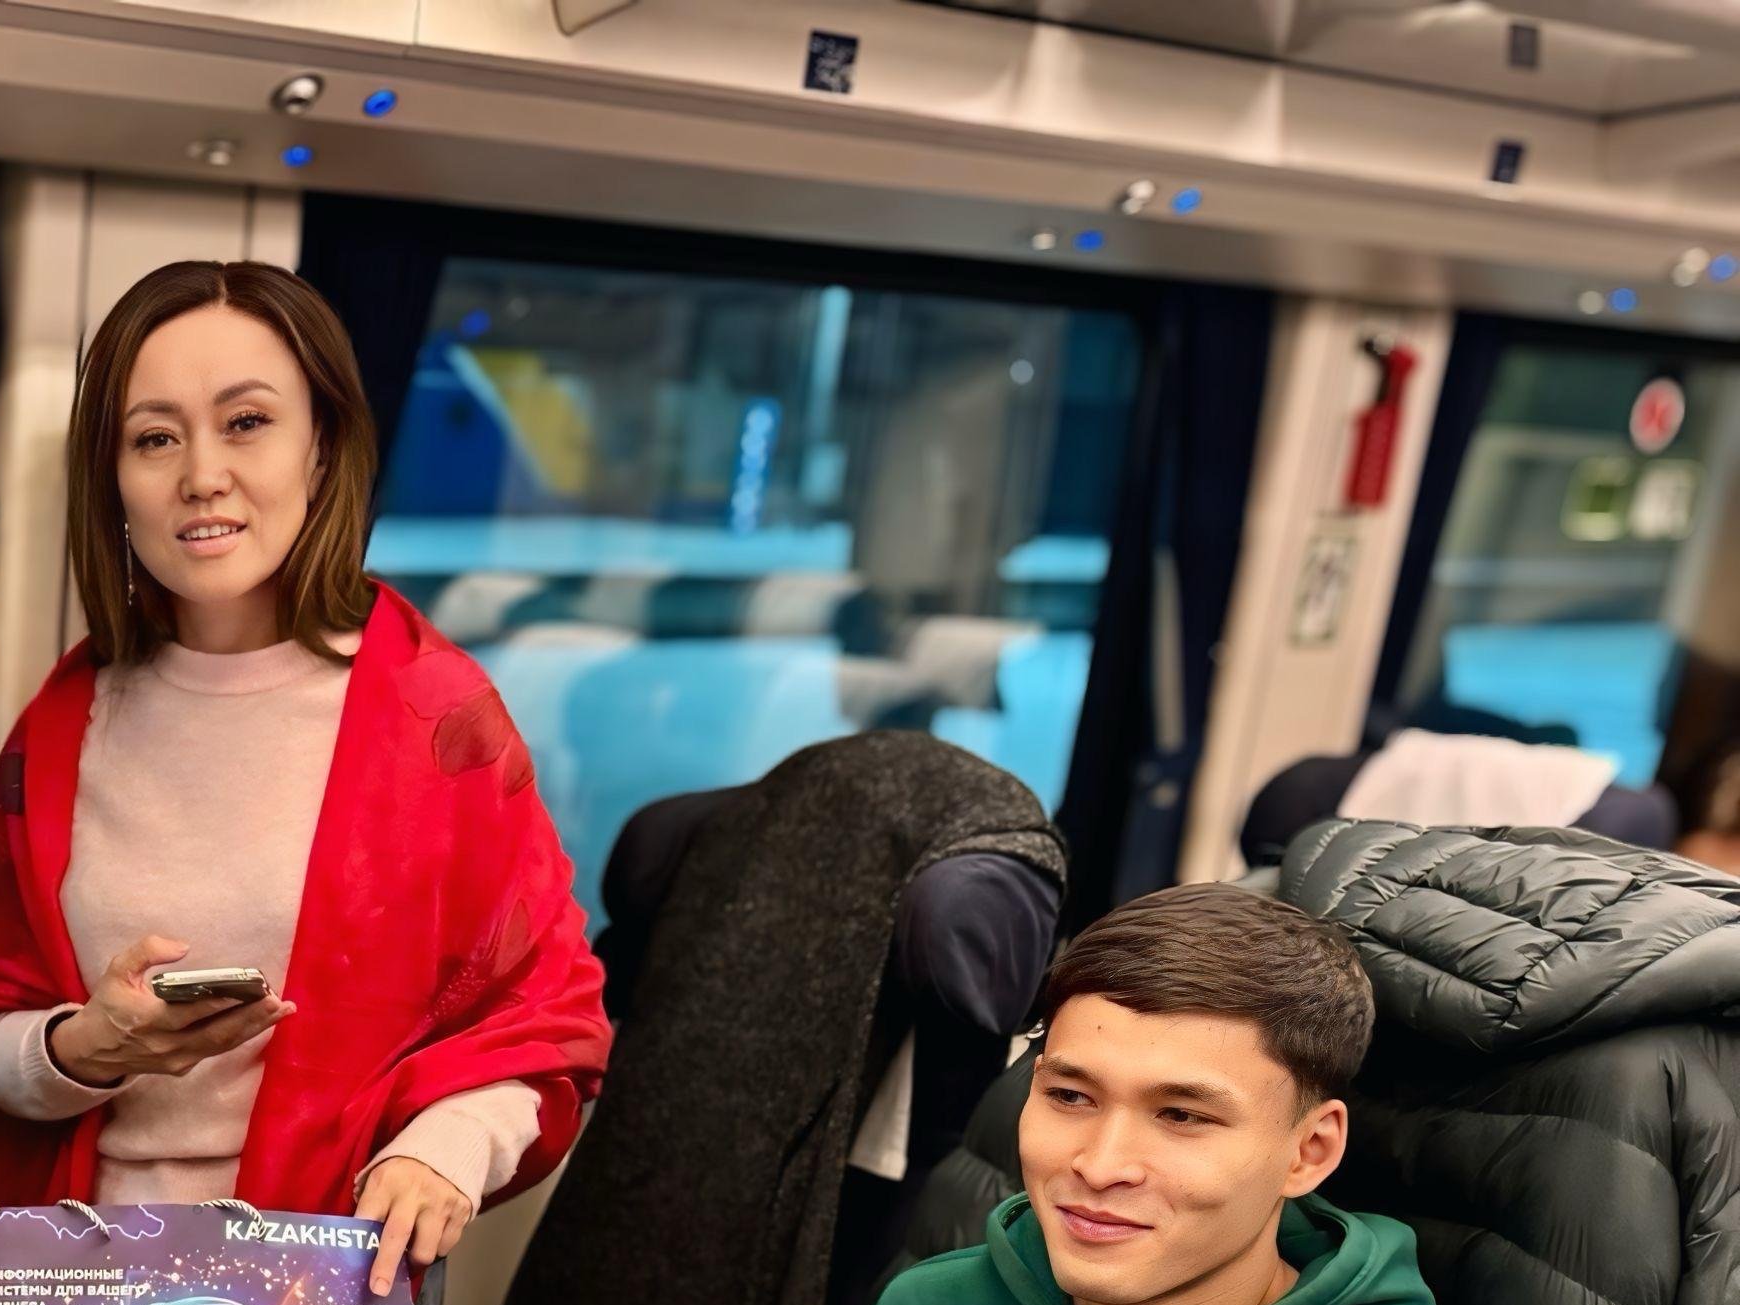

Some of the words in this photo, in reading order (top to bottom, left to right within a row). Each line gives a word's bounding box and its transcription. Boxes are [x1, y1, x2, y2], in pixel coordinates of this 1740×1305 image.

[225, 1219, 380, 1250] KAZAKHSTA
[55, 1284, 83, 1298] ДЛЯ
[88, 1284, 147, 1298] ВАШЕГО
